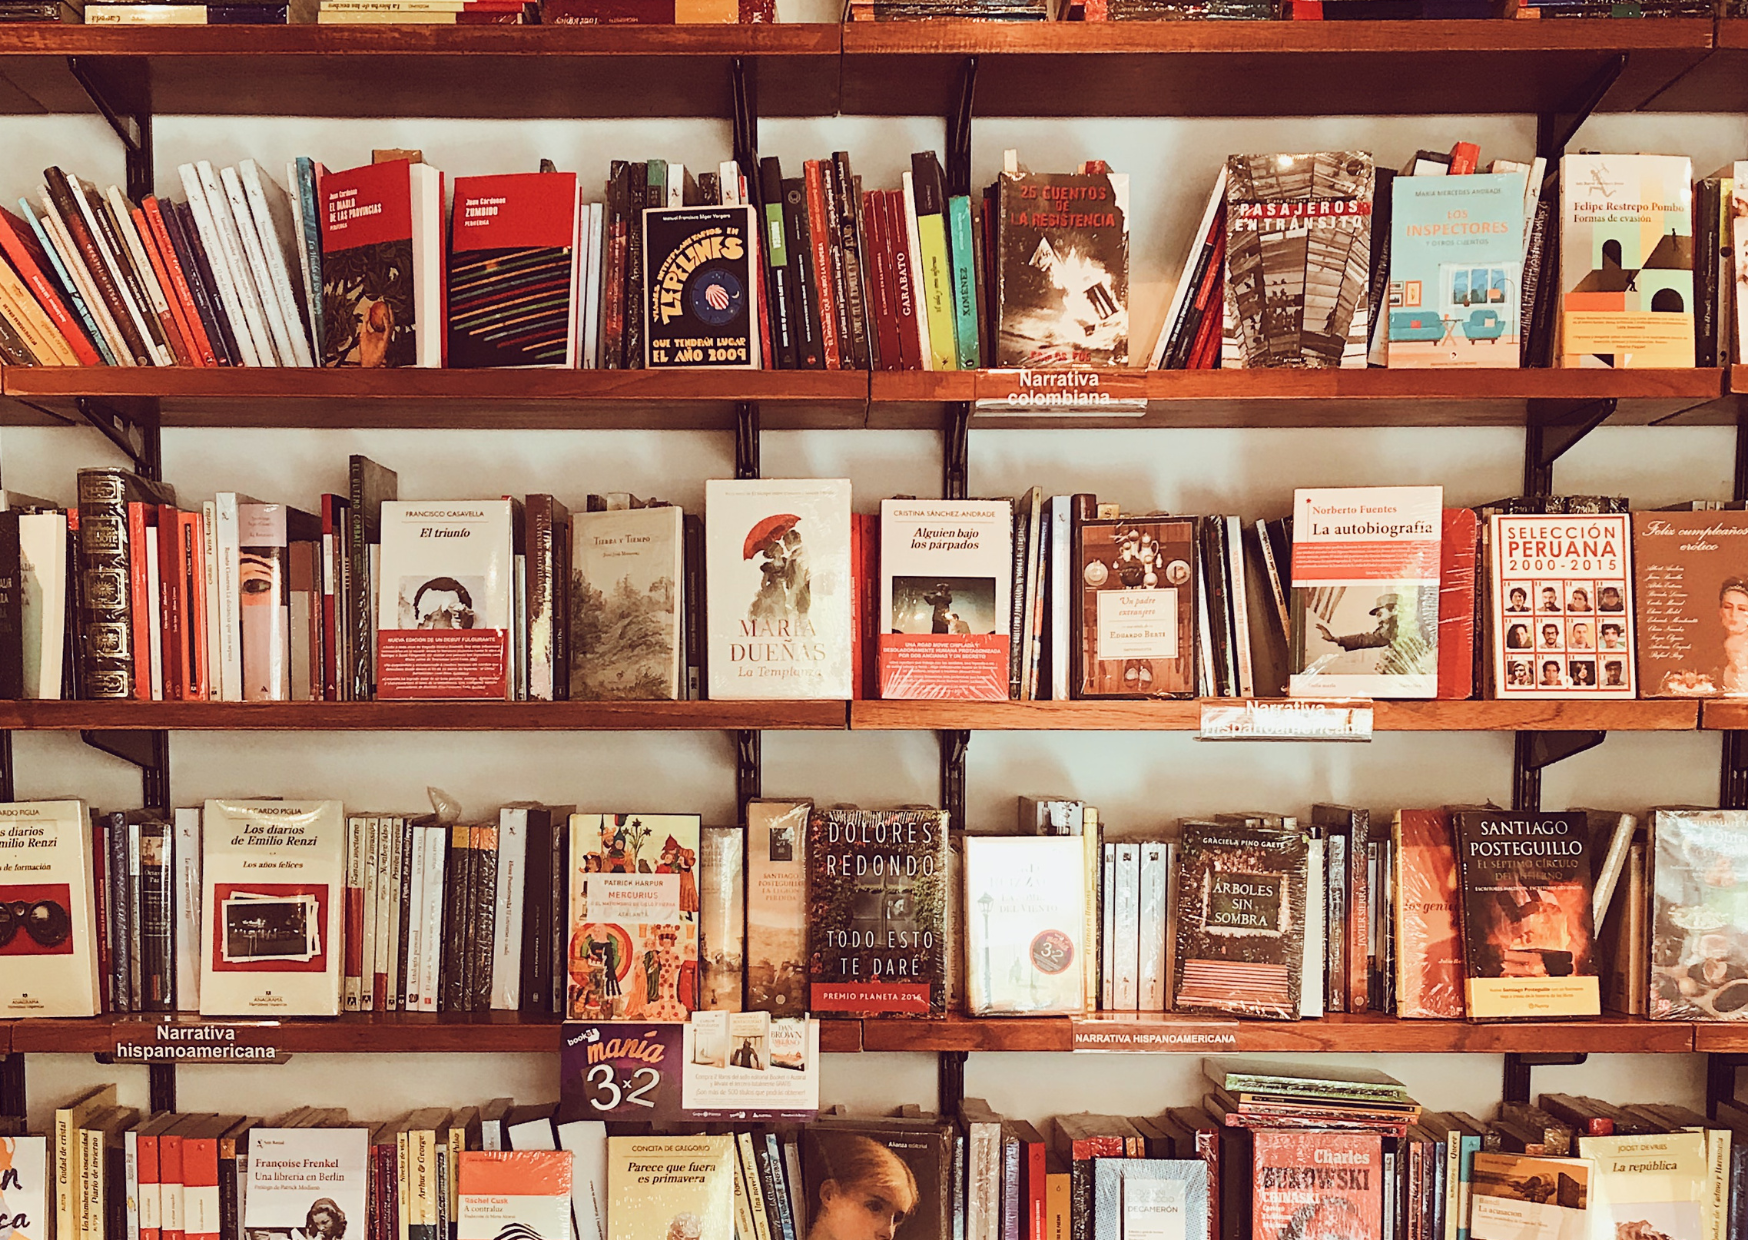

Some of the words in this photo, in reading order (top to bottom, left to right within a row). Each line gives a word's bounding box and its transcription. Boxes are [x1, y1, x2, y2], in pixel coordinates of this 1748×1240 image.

[1042, 186, 1107, 200] CUENTOS
[330, 203, 335, 212] EL
[337, 198, 355, 210] DIABLO
[1055, 201, 1069, 212] DE
[1240, 200, 1358, 216] PASAJEROS
[1574, 202, 1603, 213] Felipe
[1606, 202, 1648, 213] Restrepo
[1652, 202, 1685, 212] Pombo
[330, 214, 336, 222] DE
[338, 211, 348, 221] LAS
[349, 204, 382, 219] PROVINCIAS
[466, 207, 498, 217] ZUMBIDO
[1447, 210, 1468, 220] LOS
[1011, 213, 1028, 225] LA
[1032, 213, 1115, 227] RESISTENCIA
[1235, 218, 1257, 231] EN
[1264, 215, 1362, 230] TRÁNSITO
[1574, 214, 1605, 223] Formas
[1608, 214, 1618, 222] de
[1620, 214, 1651, 222] evasión
[727, 227, 739, 235] EN
[1407, 222, 1508, 236] INSPECTORES
[661, 236, 744, 325] ZEPELINES
[897, 253, 911, 316] GARABATO
[960, 267, 970, 316] XIMÉNEZ
[653, 339, 671, 347] QUE
[717, 338, 746, 346] LUGAR
[653, 350, 669, 362] EL
[674, 348, 703, 362] AÑO
[708, 348, 746, 361] 2009
[1020, 371, 1099, 386] Narrativa
[1008, 391, 1110, 406] colombiana
[927, 510, 996, 518] SÁNCHEZ-ANDRADE
[1313, 506, 1357, 514] Norberto
[1361, 505, 1397, 513] Fuentes
[420, 528, 432, 538] El
[435, 528, 470, 538] triunfo
[914, 528, 955, 539] Alguien
[957, 528, 979, 539] bajo
[1313, 524, 1329, 535] La
[1335, 521, 1432, 537] autobiografía
[1508, 523, 1616, 539] SELECCIÓN
[1642, 521, 1675, 536] Feliz
[911, 540, 926, 549] los
[929, 540, 979, 550] párpados
[1509, 542, 1616, 558] PERUANA
[1680, 542, 1718, 550] erótico
[1135, 597, 1156, 607] padre
[1119, 609, 1155, 617] extranjero
[730, 639, 826, 661] DUEÑAS
[738, 667, 753, 677] La
[8, 827, 44, 836] diarios
[244, 825, 264, 835] Los
[266, 824, 305, 835] diarios
[828, 822, 932, 843] DOLORES
[1481, 822, 1568, 836] SANTIAGO
[231, 836, 245, 846] de
[247, 835, 283, 846] Emilio
[285, 835, 317, 846] Renzi
[1470, 841, 1582, 856] POSTEGUILLO
[243, 860, 256, 868] Los
[278, 860, 303, 868] felices
[827, 854, 934, 876] REDONDO
[1476, 859, 1489, 868] EL
[1491, 858, 1534, 868] SÉPTIMO
[1536, 858, 1578, 868] CÍRCULO
[1214, 878, 1273, 897] ÁRBOLES
[1233, 898, 1253, 909] SIN
[1358, 884, 1367, 917] SIERRA
[1215, 912, 1267, 926] SOMBRA
[1358, 920, 1367, 946] JAVIER
[827, 931, 874, 948] TODO
[888, 931, 934, 949] ESTO
[840, 958, 860, 976] TE
[874, 954, 920, 976] DARÉ
[823, 992, 857, 1001] PREMIO
[859, 993, 898, 1001] PLANETA
[157, 1026, 235, 1041] Narrativa
[1075, 1034, 1131, 1043] NARRATIVA
[1133, 1034, 1235, 1043] HISPANOAMERICANA
[117, 1043, 275, 1060] hispanoamericana
[588, 1031, 664, 1064] manía
[60, 1147, 66, 1156] de
[1314, 1149, 1369, 1164] Charles
[255, 1158, 300, 1170] Françoise
[303, 1158, 339, 1168] Frenkel
[628, 1161, 662, 1172] Parece
[665, 1163, 685, 1174] que
[688, 1162, 715, 1172] fuera
[1613, 1162, 1628, 1172] La
[1630, 1161, 1677, 1173] república
[255, 1172, 270, 1181] Una
[637, 1175, 649, 1183] es
[651, 1174, 705, 1184] primavera
[83, 1180, 88, 1190] en
[472, 1205, 503, 1213] contraluz
[1128, 1205, 1178, 1213] DECAMERÓN
[83, 1221, 89, 1231] Un
